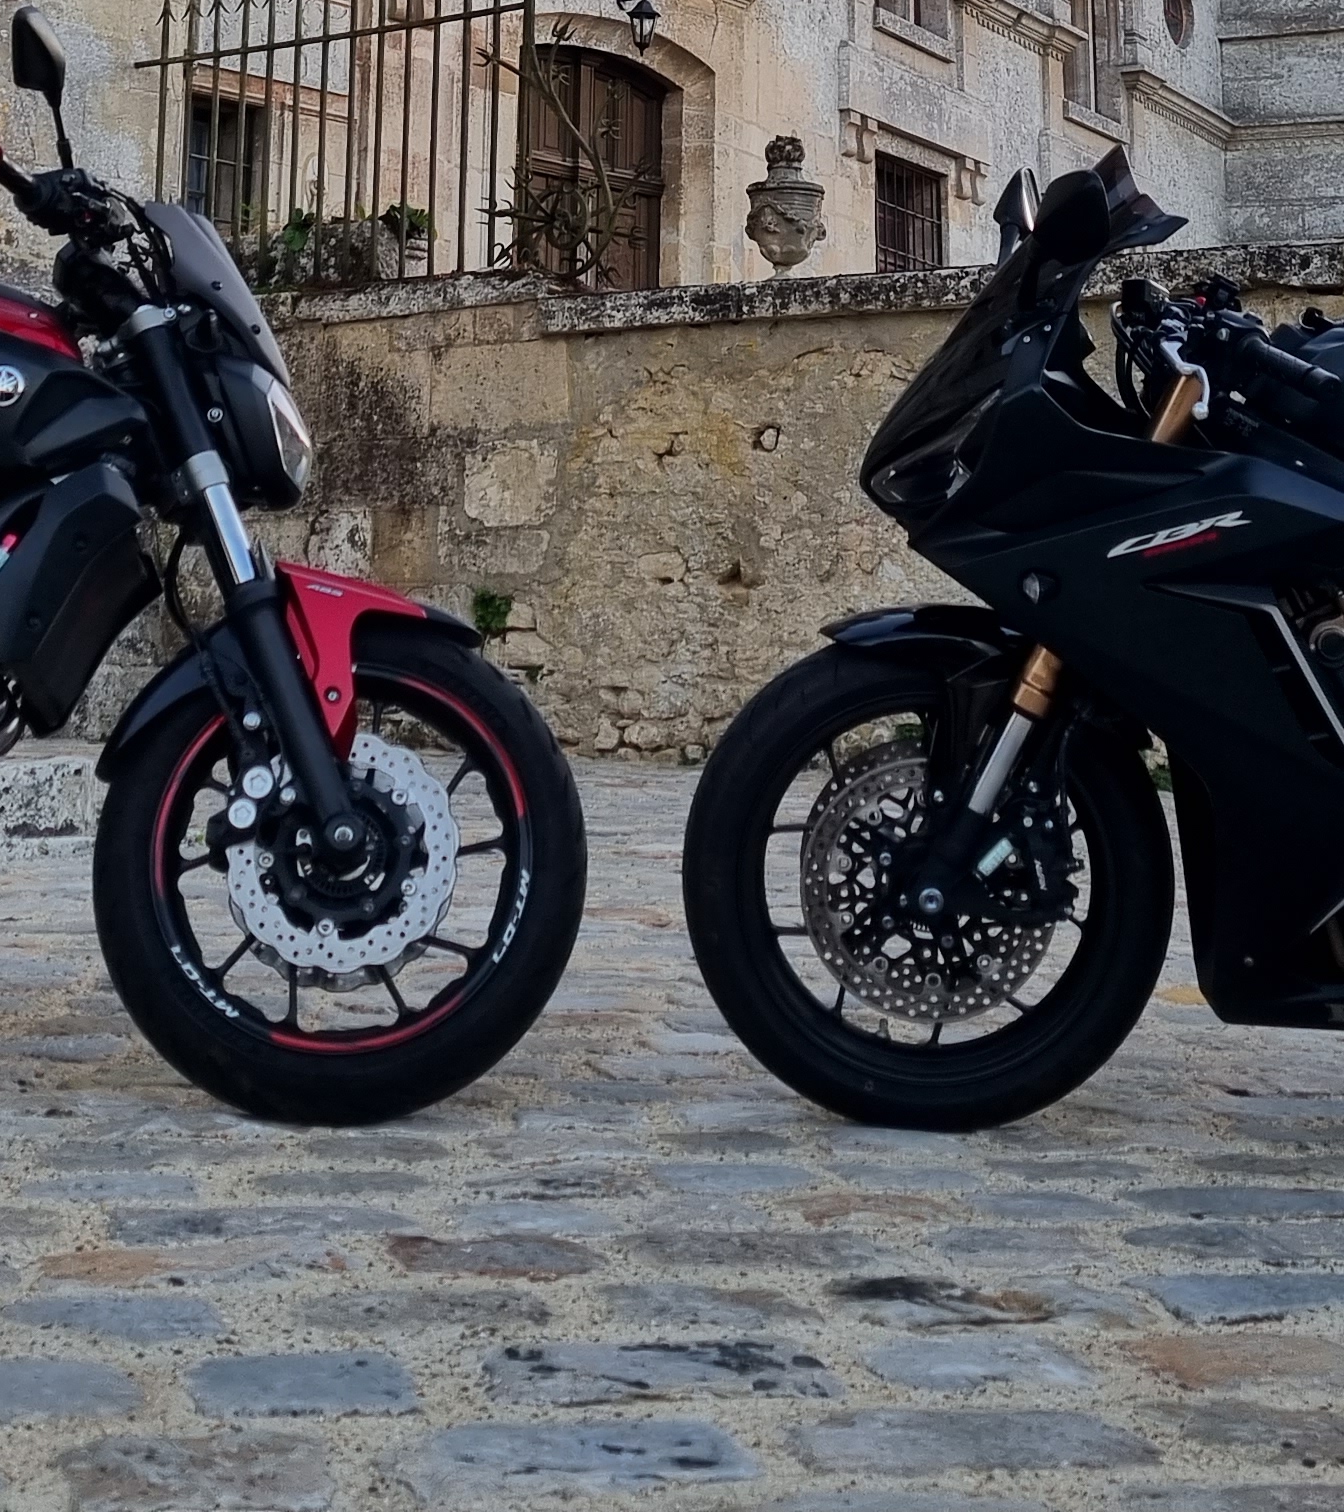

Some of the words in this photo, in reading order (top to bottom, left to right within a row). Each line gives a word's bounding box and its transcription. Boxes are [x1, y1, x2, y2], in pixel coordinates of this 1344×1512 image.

[1106, 510, 1254, 559] CBR
[492, 869, 530, 964] MT-07
[170, 943, 240, 1018] MT-07
